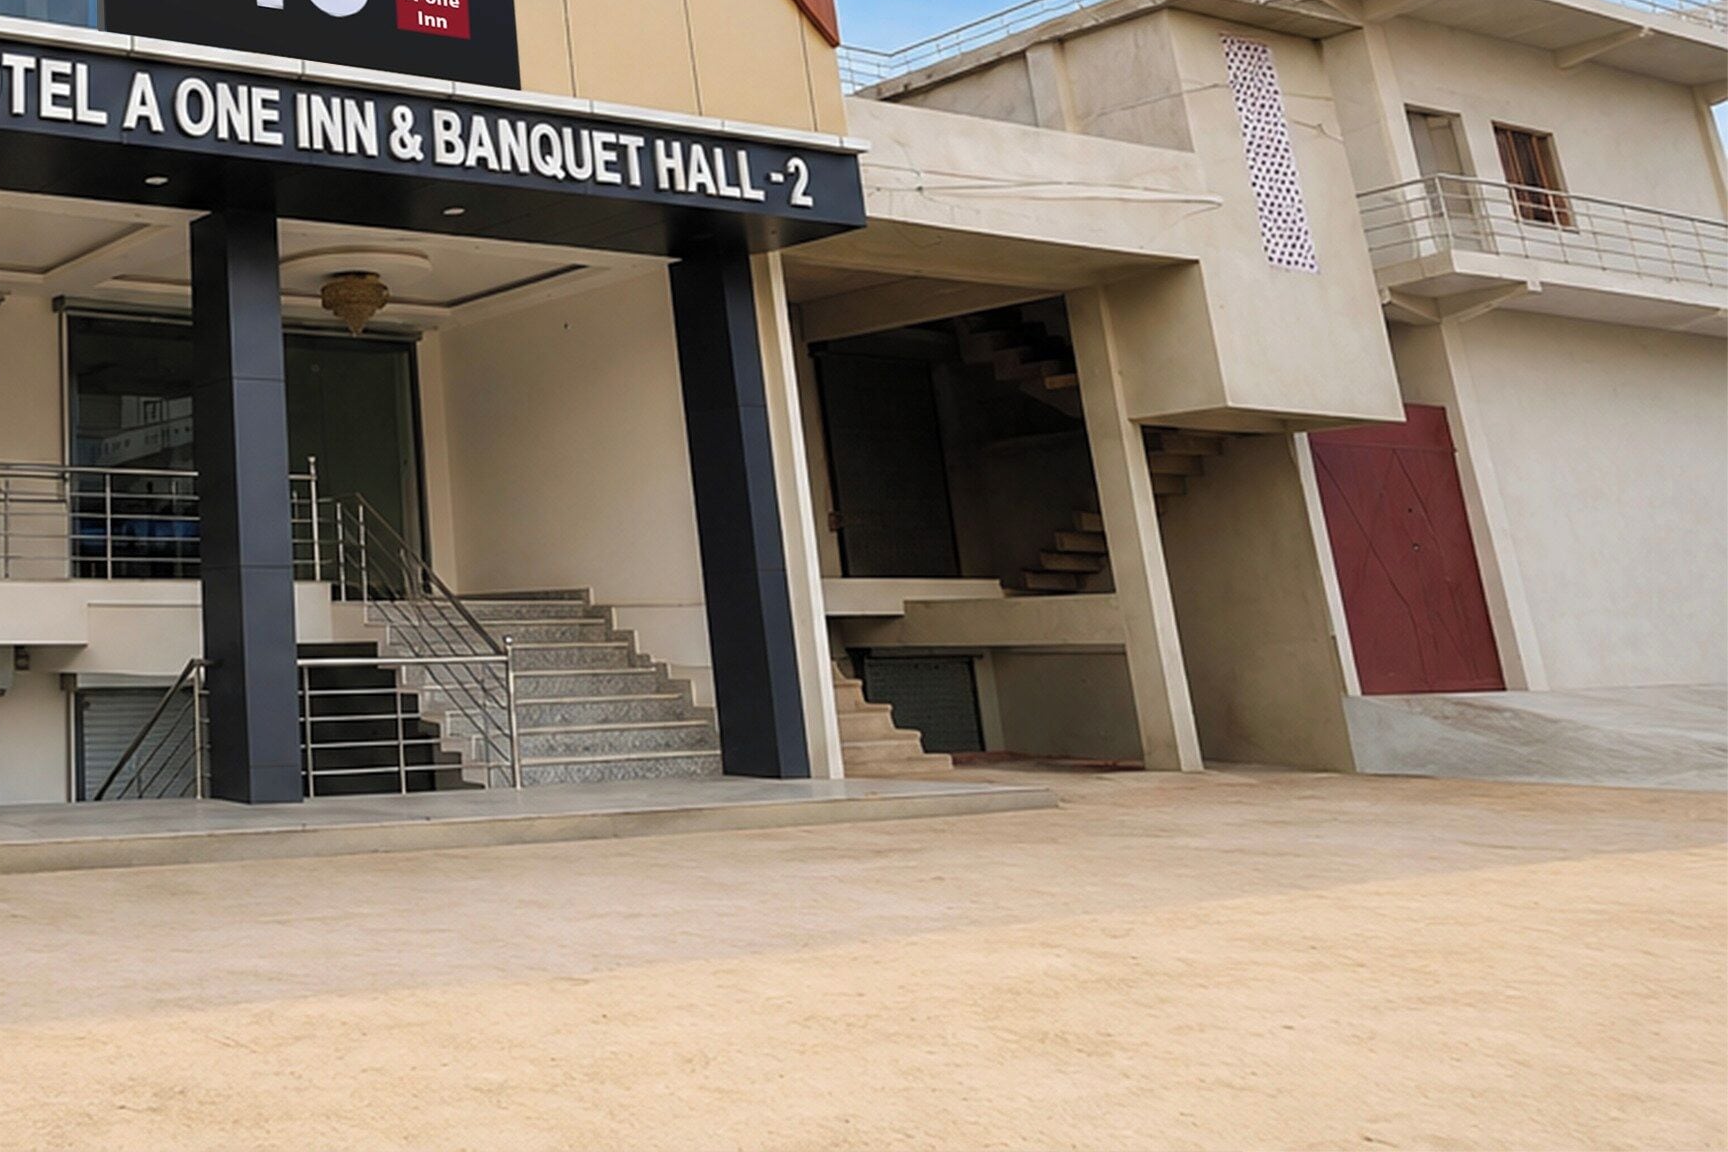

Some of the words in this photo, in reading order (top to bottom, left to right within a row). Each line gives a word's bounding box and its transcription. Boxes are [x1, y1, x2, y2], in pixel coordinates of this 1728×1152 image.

[417, 10, 448, 29] Inn
[122, 71, 165, 133] A
[175, 77, 284, 147] ONE
[296, 92, 379, 157] INN
[389, 105, 425, 162] &
[432, 108, 645, 188] BANQUET
[654, 139, 766, 202] HALL
